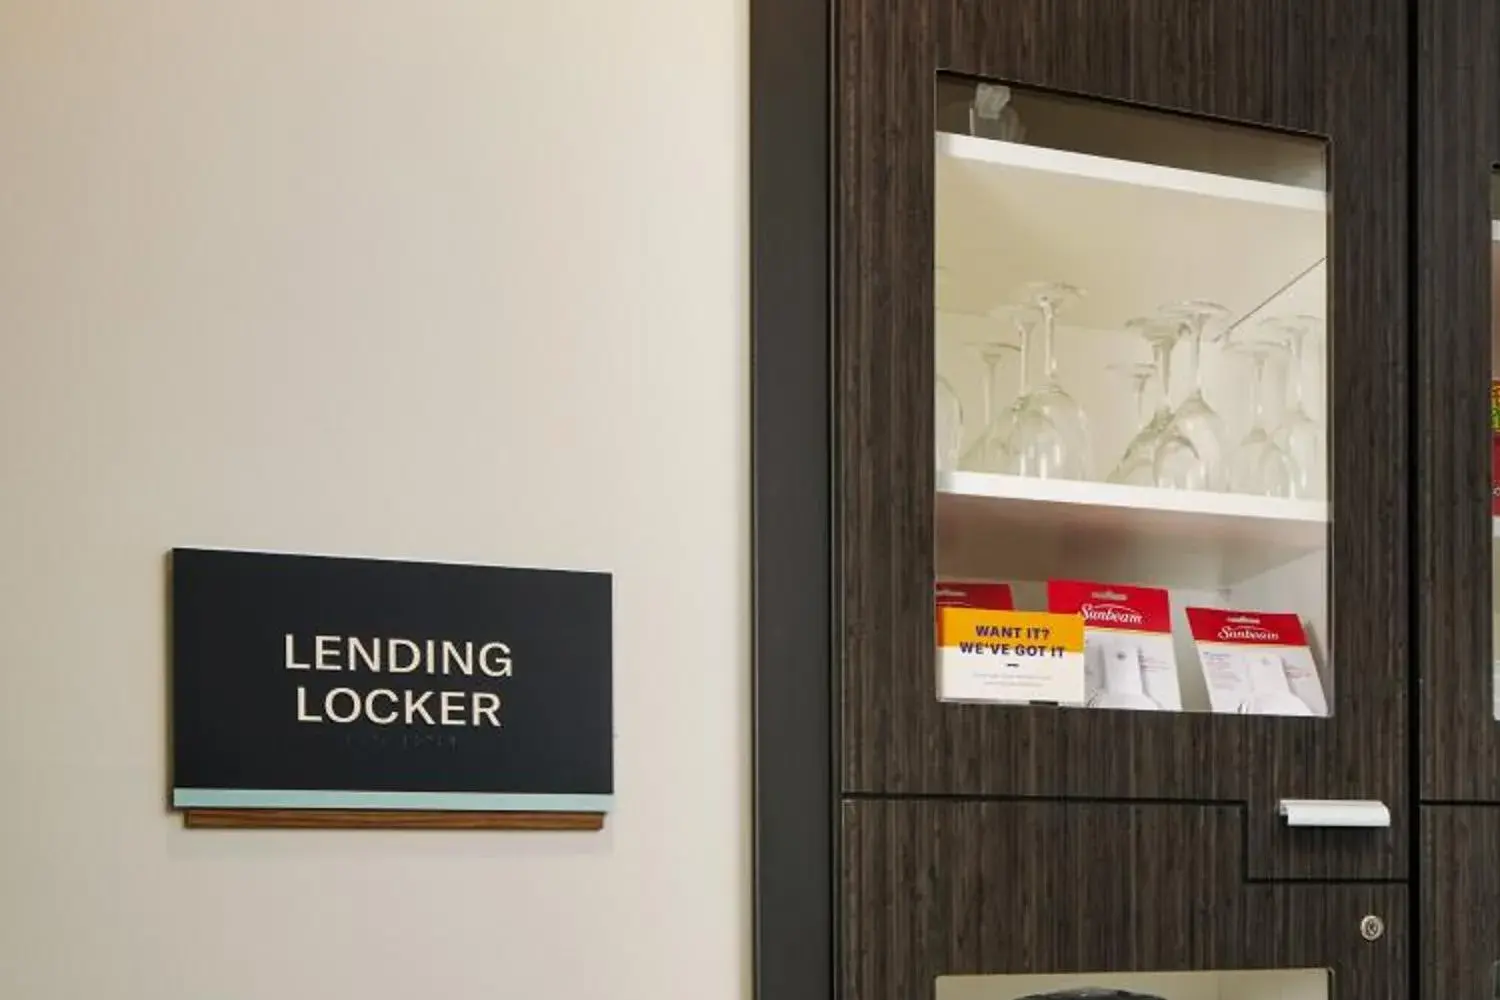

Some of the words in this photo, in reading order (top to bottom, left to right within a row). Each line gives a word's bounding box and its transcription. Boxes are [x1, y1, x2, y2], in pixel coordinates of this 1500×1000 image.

[1081, 603, 1144, 625] Sunbeam
[975, 624, 1021, 639] WANT
[1027, 627, 1051, 641] IT?
[1216, 624, 1280, 641] Sunbeam
[284, 633, 513, 677] LENDING
[959, 640, 1010, 656] WE'VE
[1015, 644, 1046, 658] GOT
[1051, 646, 1065, 659] IT
[297, 686, 502, 727] LOCKER
